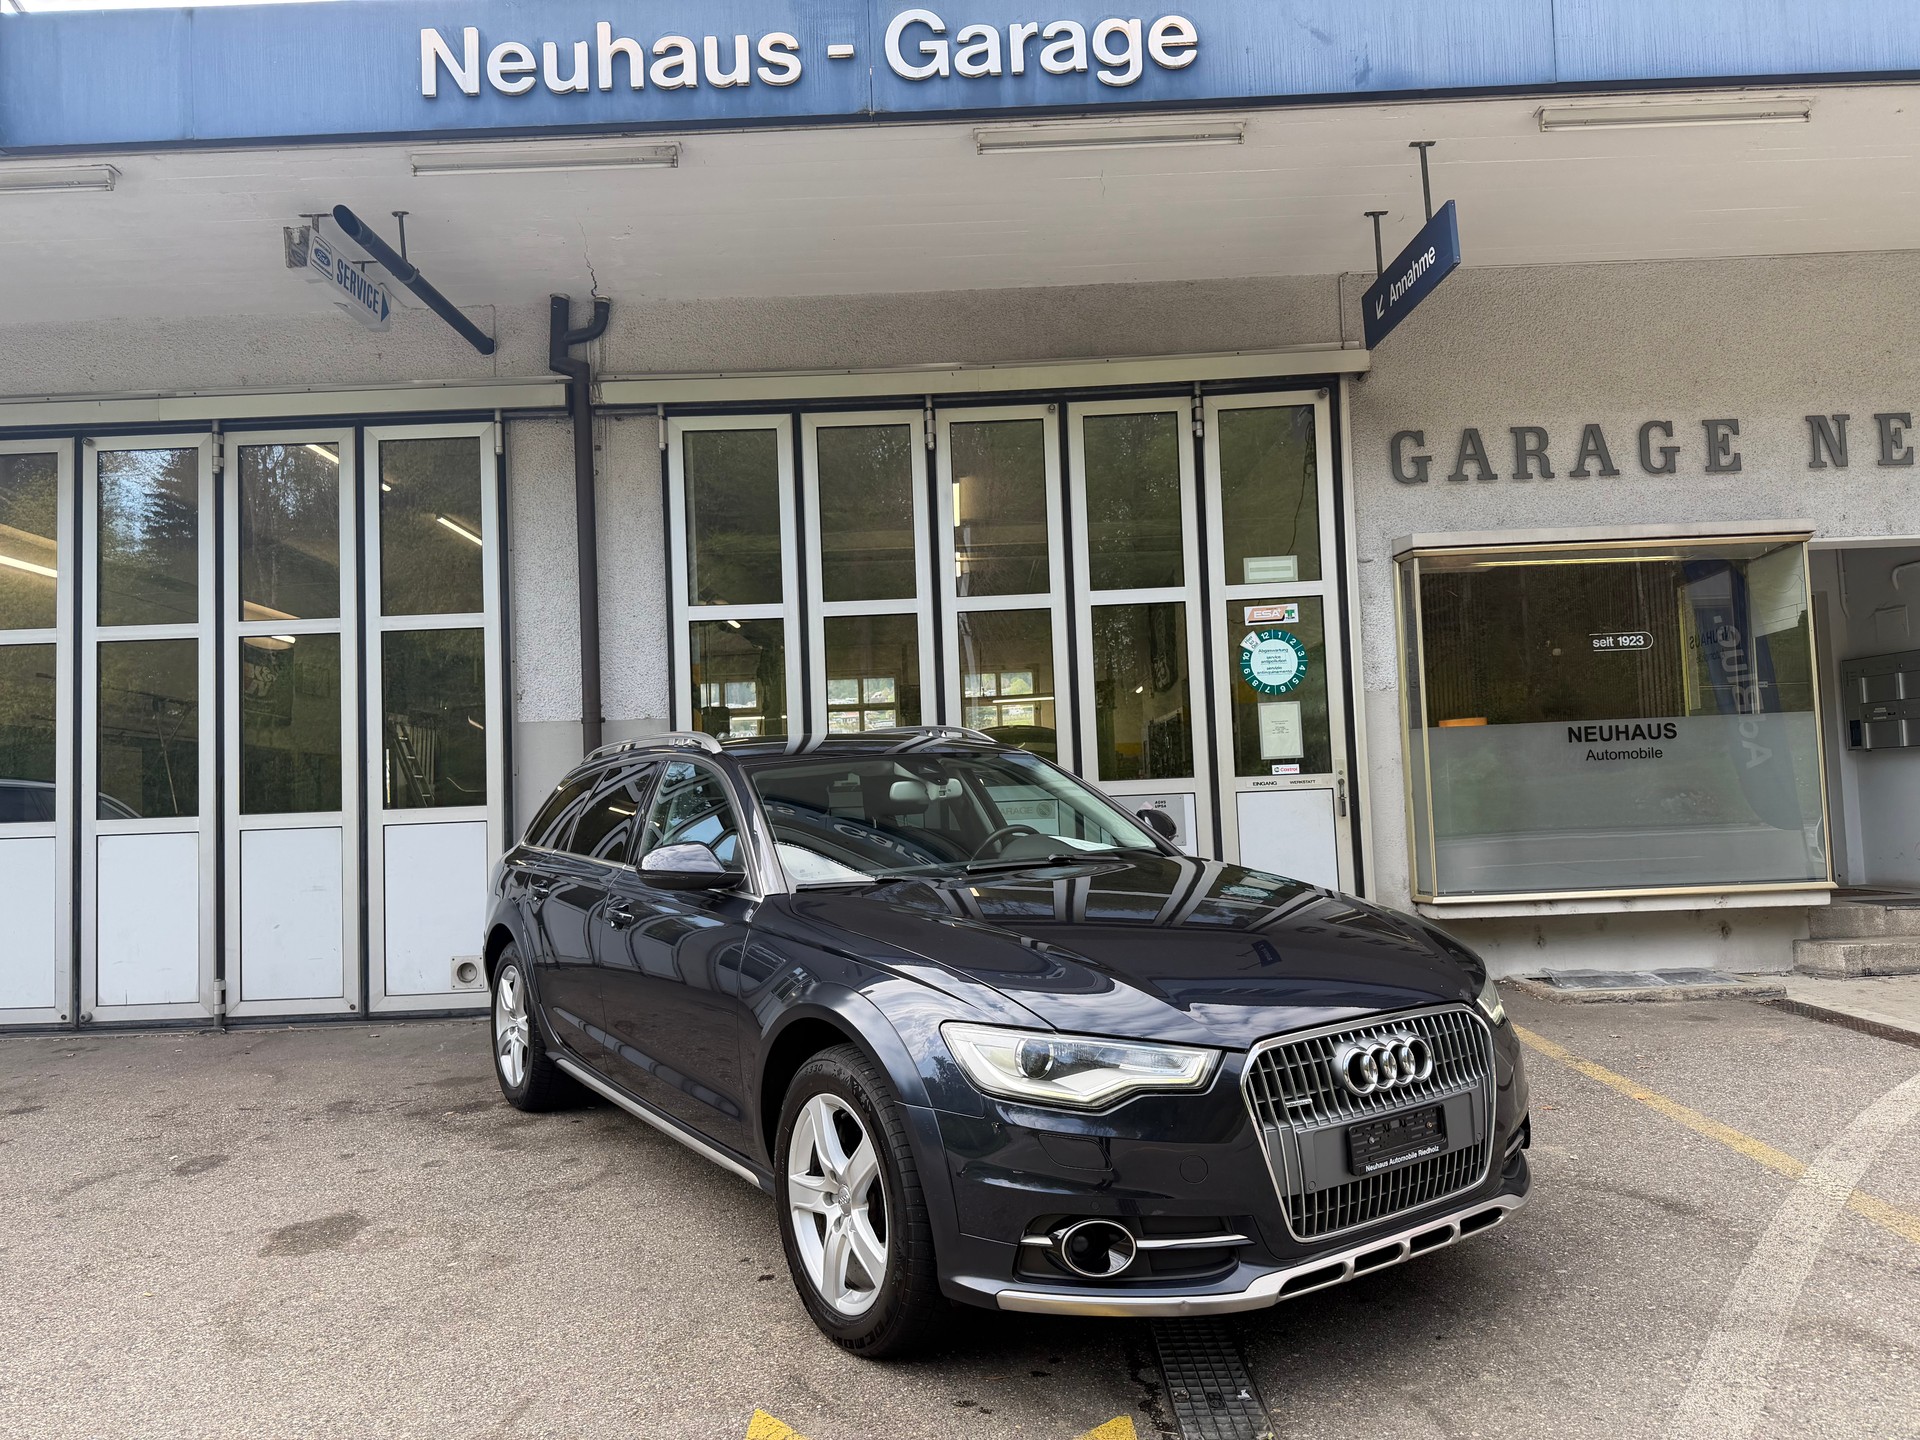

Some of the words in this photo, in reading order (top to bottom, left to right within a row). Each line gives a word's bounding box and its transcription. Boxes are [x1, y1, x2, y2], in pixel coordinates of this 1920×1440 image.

[419, 21, 803, 98] Neuhaus
[827, 43, 854, 59] -
[884, 8, 1199, 87] Garage
[1389, 246, 1436, 307] Annahme
[336, 258, 379, 315] SERVICE
[1390, 418, 1742, 485] GARAGE
[1805, 411, 1915, 469] NE
[1261, 632, 1269, 640] 12
[1290, 638, 1297, 646] 2
[1592, 637, 1614, 648] seit
[1616, 635, 1644, 647] 1923
[1242, 652, 1250, 660] 10
[1292, 677, 1300, 685] 5
[1567, 722, 1678, 743] NEUHAUS
[1586, 747, 1663, 761] Automobile
[1000, 806, 1033, 815] ARAGE
[1365, 1158, 1389, 1172] Neuhaus
[1389, 1151, 1417, 1165] Automobile
[1418, 1145, 1439, 1158] Riedholz
